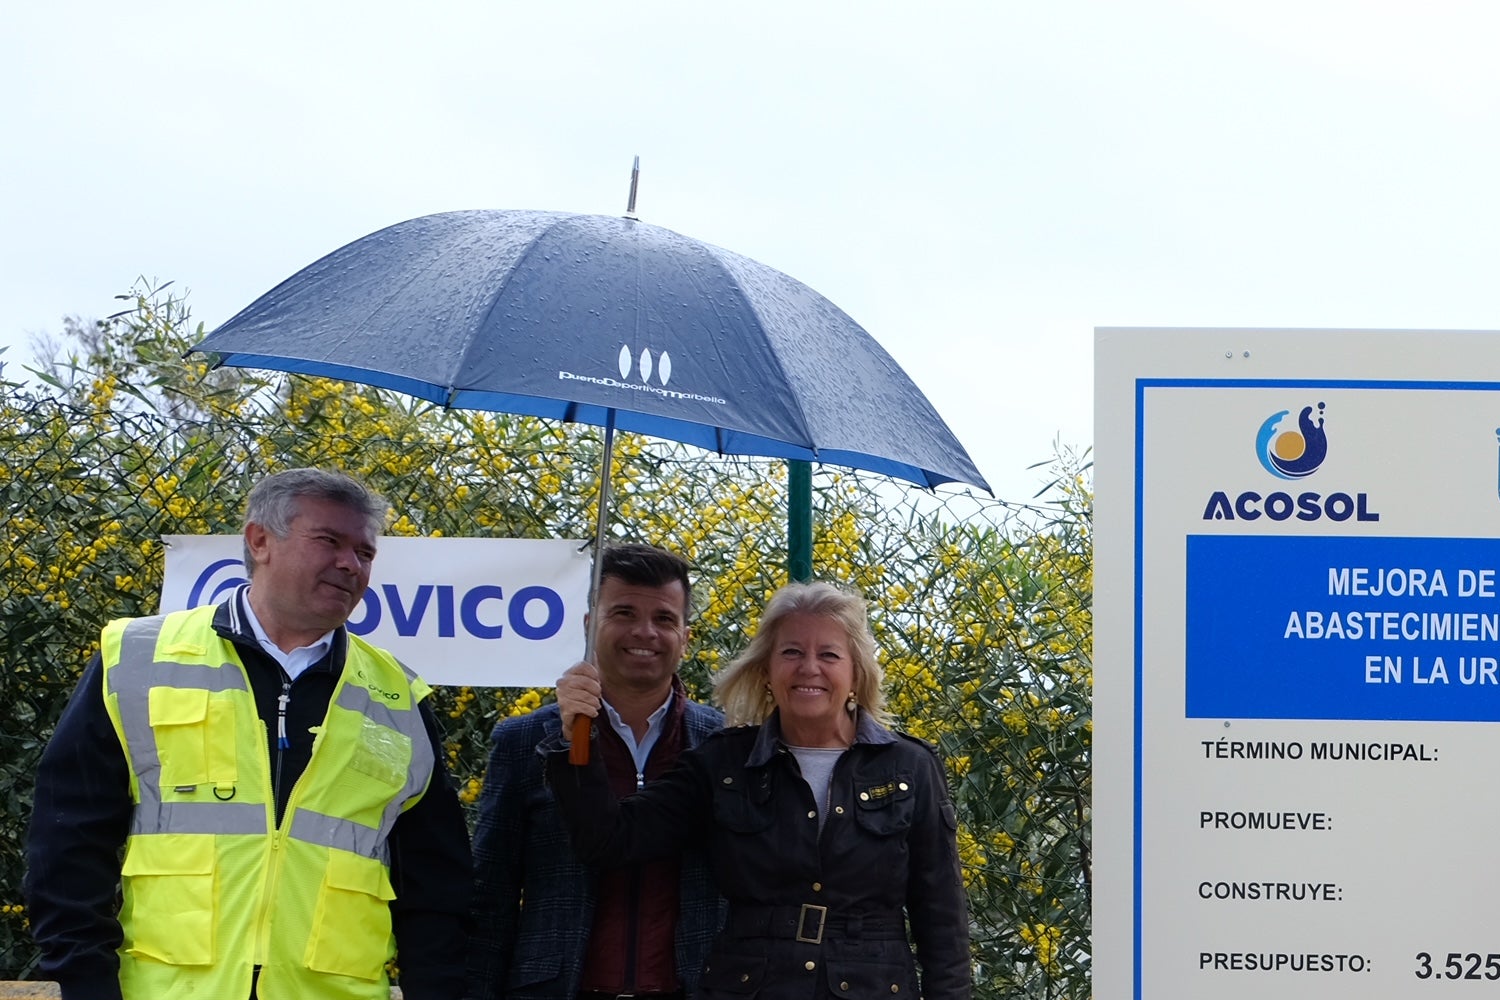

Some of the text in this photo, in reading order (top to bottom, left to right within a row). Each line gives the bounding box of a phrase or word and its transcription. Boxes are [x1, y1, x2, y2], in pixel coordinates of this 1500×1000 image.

[1202, 491, 1380, 522] ACOSOL
[1328, 567, 1449, 598] MEJORA
[1458, 569, 1496, 598] DE
[1365, 655, 1402, 684] EN
[1412, 656, 1450, 685] LA
[1201, 737, 1439, 762] TÉRMINO MUNICIPAL:
[1200, 811, 1333, 831] PROMUEVE:
[1198, 881, 1344, 901] CONSTRUYE:
[1199, 952, 1373, 973] PRESUPUESTO:
